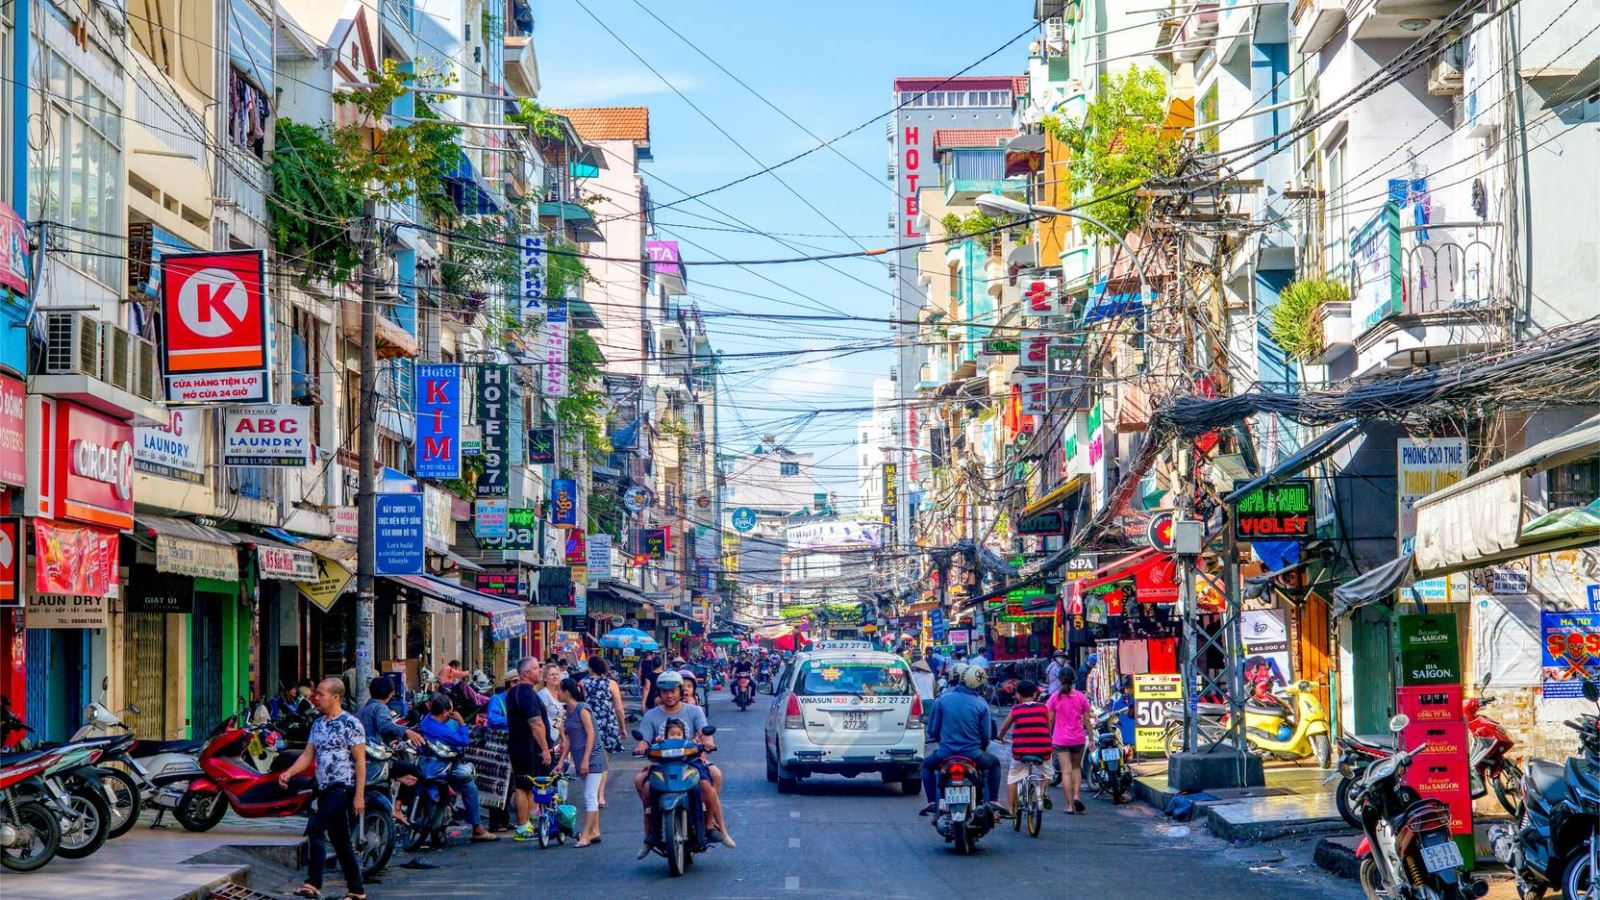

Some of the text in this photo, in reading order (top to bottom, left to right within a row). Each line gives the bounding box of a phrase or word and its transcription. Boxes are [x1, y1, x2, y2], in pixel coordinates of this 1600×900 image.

[905, 127, 921, 238] HOTEL
[197, 282, 243, 332] K
[421, 367, 456, 377] Hotel
[193, 376, 218, 387] HÀNG
[220, 390, 232, 398] 24
[235, 418, 298, 434] ABC
[424, 380, 452, 461] KIM
[143, 434, 190, 458] LAUNDRY
[230, 437, 302, 447] LAUNDRY
[79, 441, 118, 483] CIRCLE
[557, 488, 573, 522] Tiger
[1279, 488, 1308, 511] NAIL
[1241, 518, 1307, 534] VIOLET
[265, 550, 274, 568] 85
[1069, 558, 1094, 569] SPA
[29, 595, 102, 606] LAUN DRY
[1432, 782, 1459, 790] SAIGON
